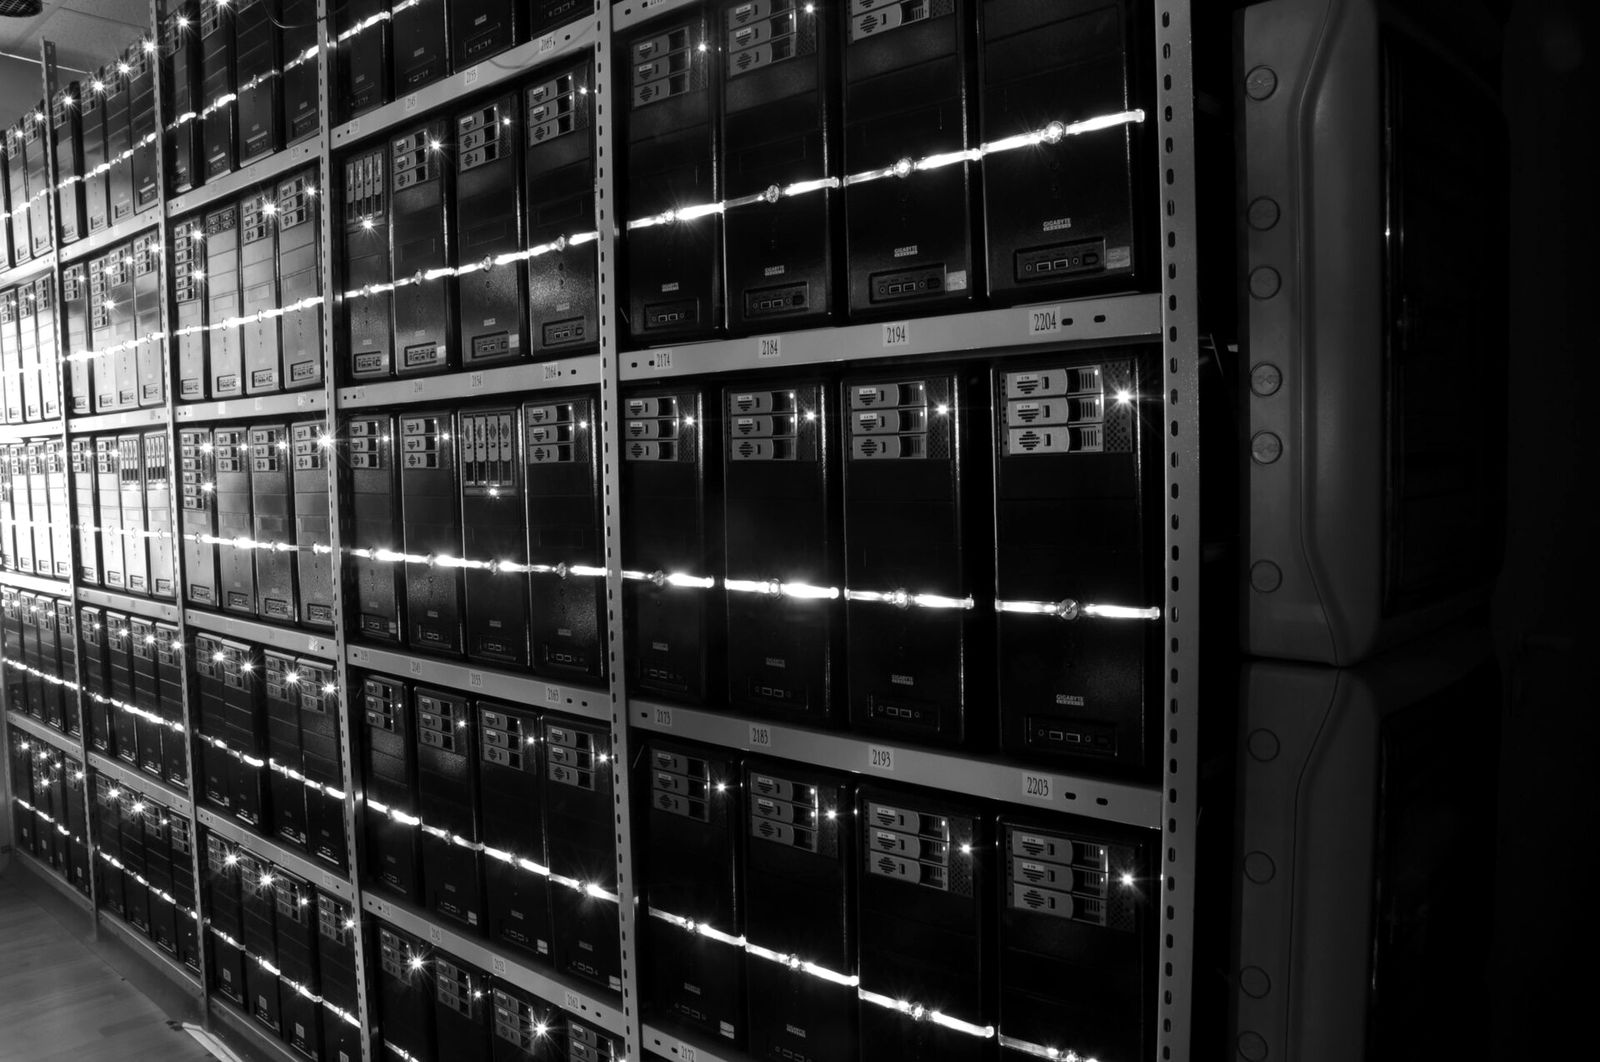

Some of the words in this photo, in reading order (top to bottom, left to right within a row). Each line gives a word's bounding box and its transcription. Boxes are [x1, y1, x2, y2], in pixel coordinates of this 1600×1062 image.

[1034, 310, 1056, 331] 2204
[887, 325, 905, 344] 2194
[762, 339, 778, 355] 2184
[657, 353, 671, 368] 2174
[657, 709, 671, 725] 2173
[752, 727, 768, 744] 2183
[872, 748, 891, 767] 2193
[1027, 776, 1049, 797] 2203
